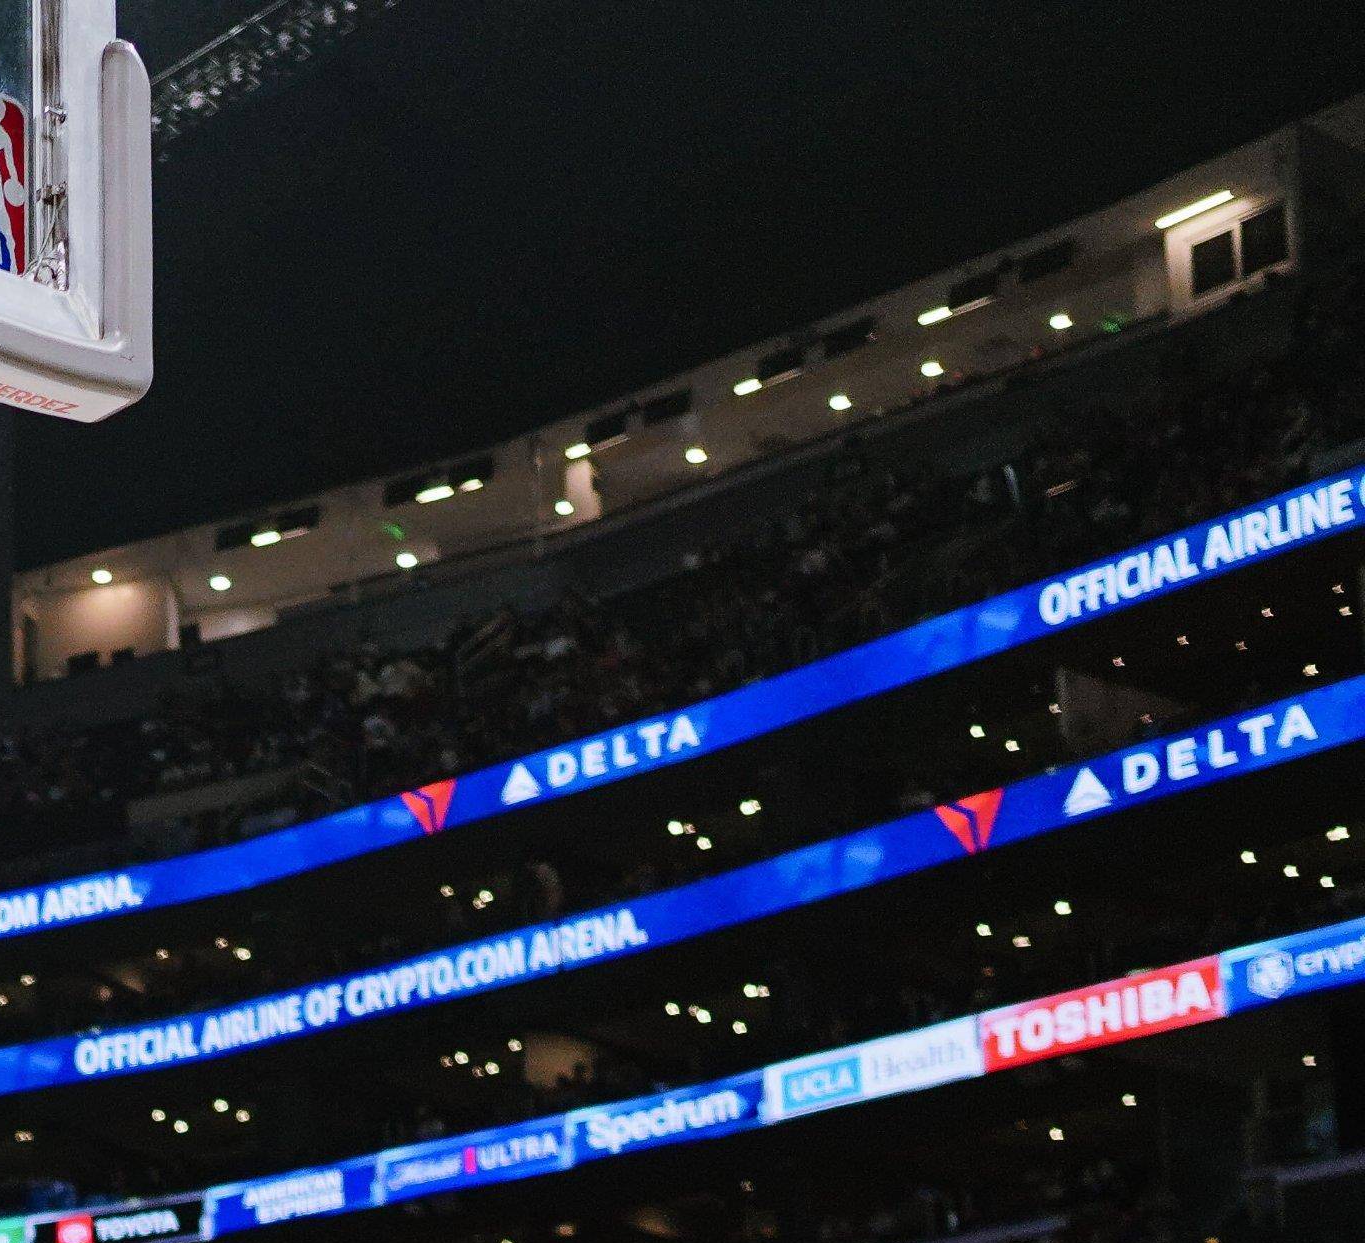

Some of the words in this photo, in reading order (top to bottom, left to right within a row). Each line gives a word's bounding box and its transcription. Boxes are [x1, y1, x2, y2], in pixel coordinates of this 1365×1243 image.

[1039, 537, 1199, 626] OFFICIAL
[1202, 477, 1355, 570] AIRLINE
[548, 715, 699, 789] DELTA
[1121, 703, 1318, 794] DELTA
[42, 874, 144, 924] ARENA.
[74, 1020, 199, 1075] OFFICIAL
[199, 994, 303, 1054] AIRLINE
[303, 983, 343, 1027] OF
[344, 937, 526, 1016] CRYPTO.COM
[529, 908, 649, 970] ARENA.
[990, 970, 1212, 1059] TOSHIBA
[477, 1132, 559, 1170] ULTRA
[586, 1090, 740, 1153] Spectrum
[94, 1210, 180, 1243] TOYOTA
